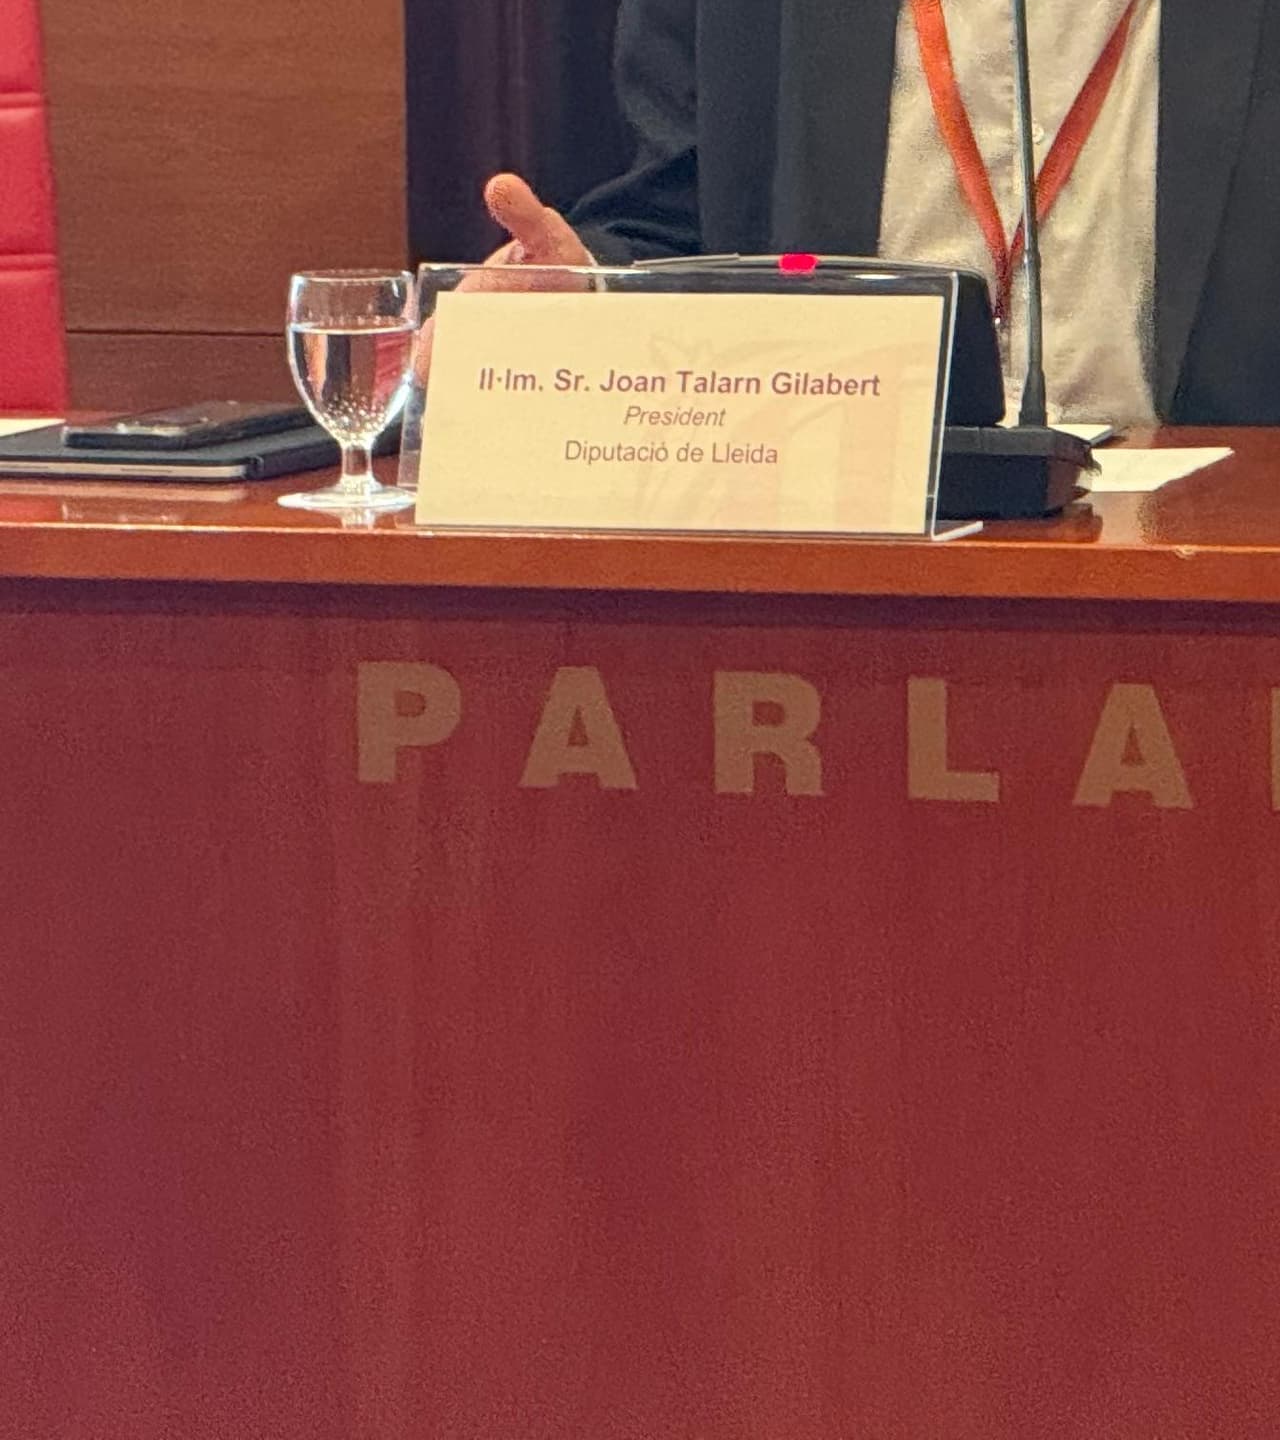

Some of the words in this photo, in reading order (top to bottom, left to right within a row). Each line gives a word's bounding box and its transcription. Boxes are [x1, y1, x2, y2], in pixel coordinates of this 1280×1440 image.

[553, 367, 591, 393] Sr.
[599, 368, 667, 393] Joan
[675, 370, 761, 395] Talarn
[770, 371, 881, 397] Gilabert
[623, 405, 727, 427] President
[564, 439, 669, 466] Diputació
[676, 441, 705, 464] de
[711, 442, 779, 464] Lleida
